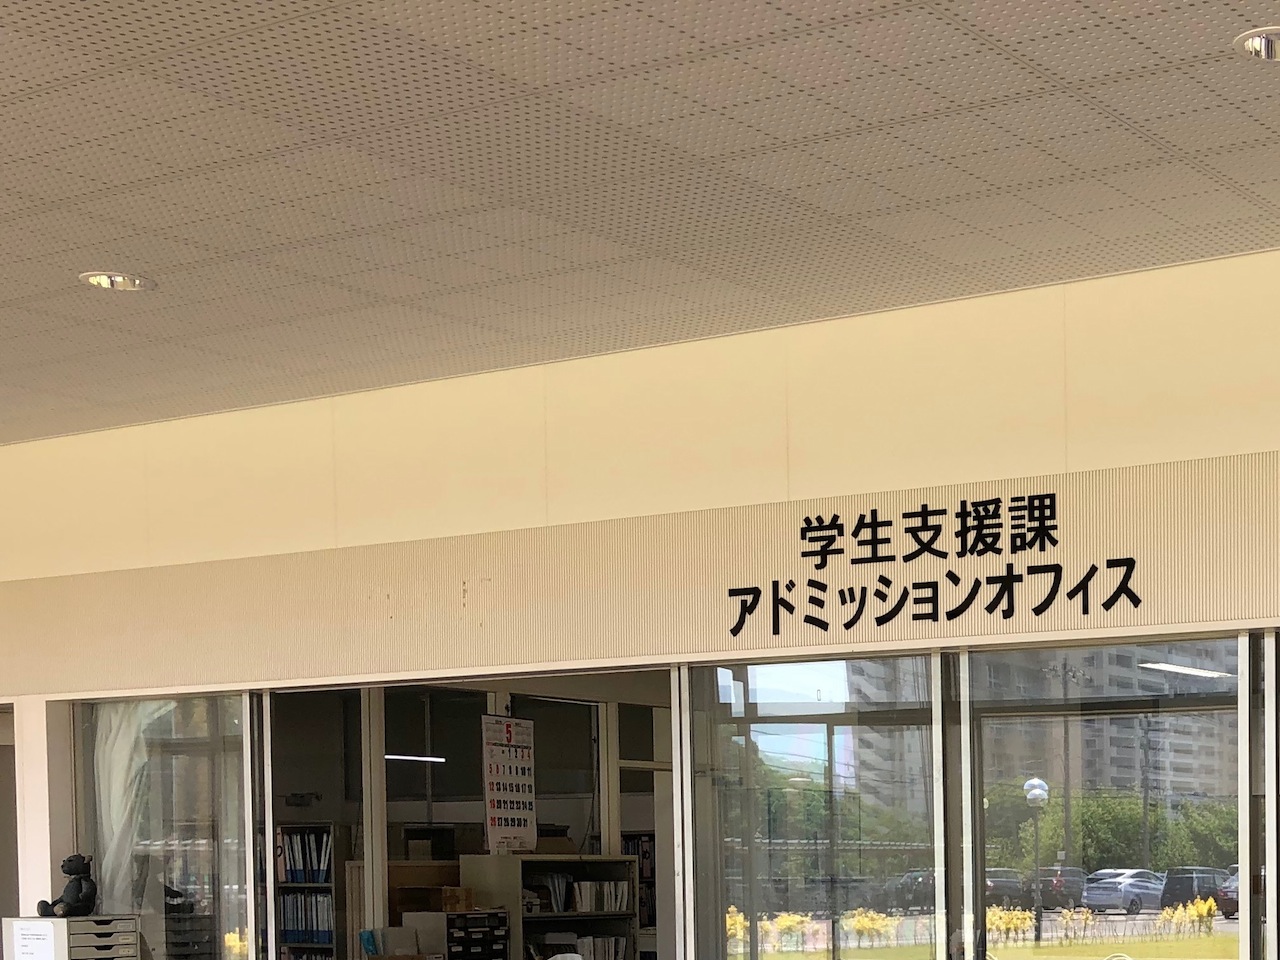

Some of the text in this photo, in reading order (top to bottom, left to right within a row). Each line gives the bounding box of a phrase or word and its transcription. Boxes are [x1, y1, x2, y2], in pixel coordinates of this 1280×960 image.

[800, 493, 1059, 570] 学生支援課
[728, 557, 1142, 637] アドミッションオフィス
[505, 722, 513, 744] 5
